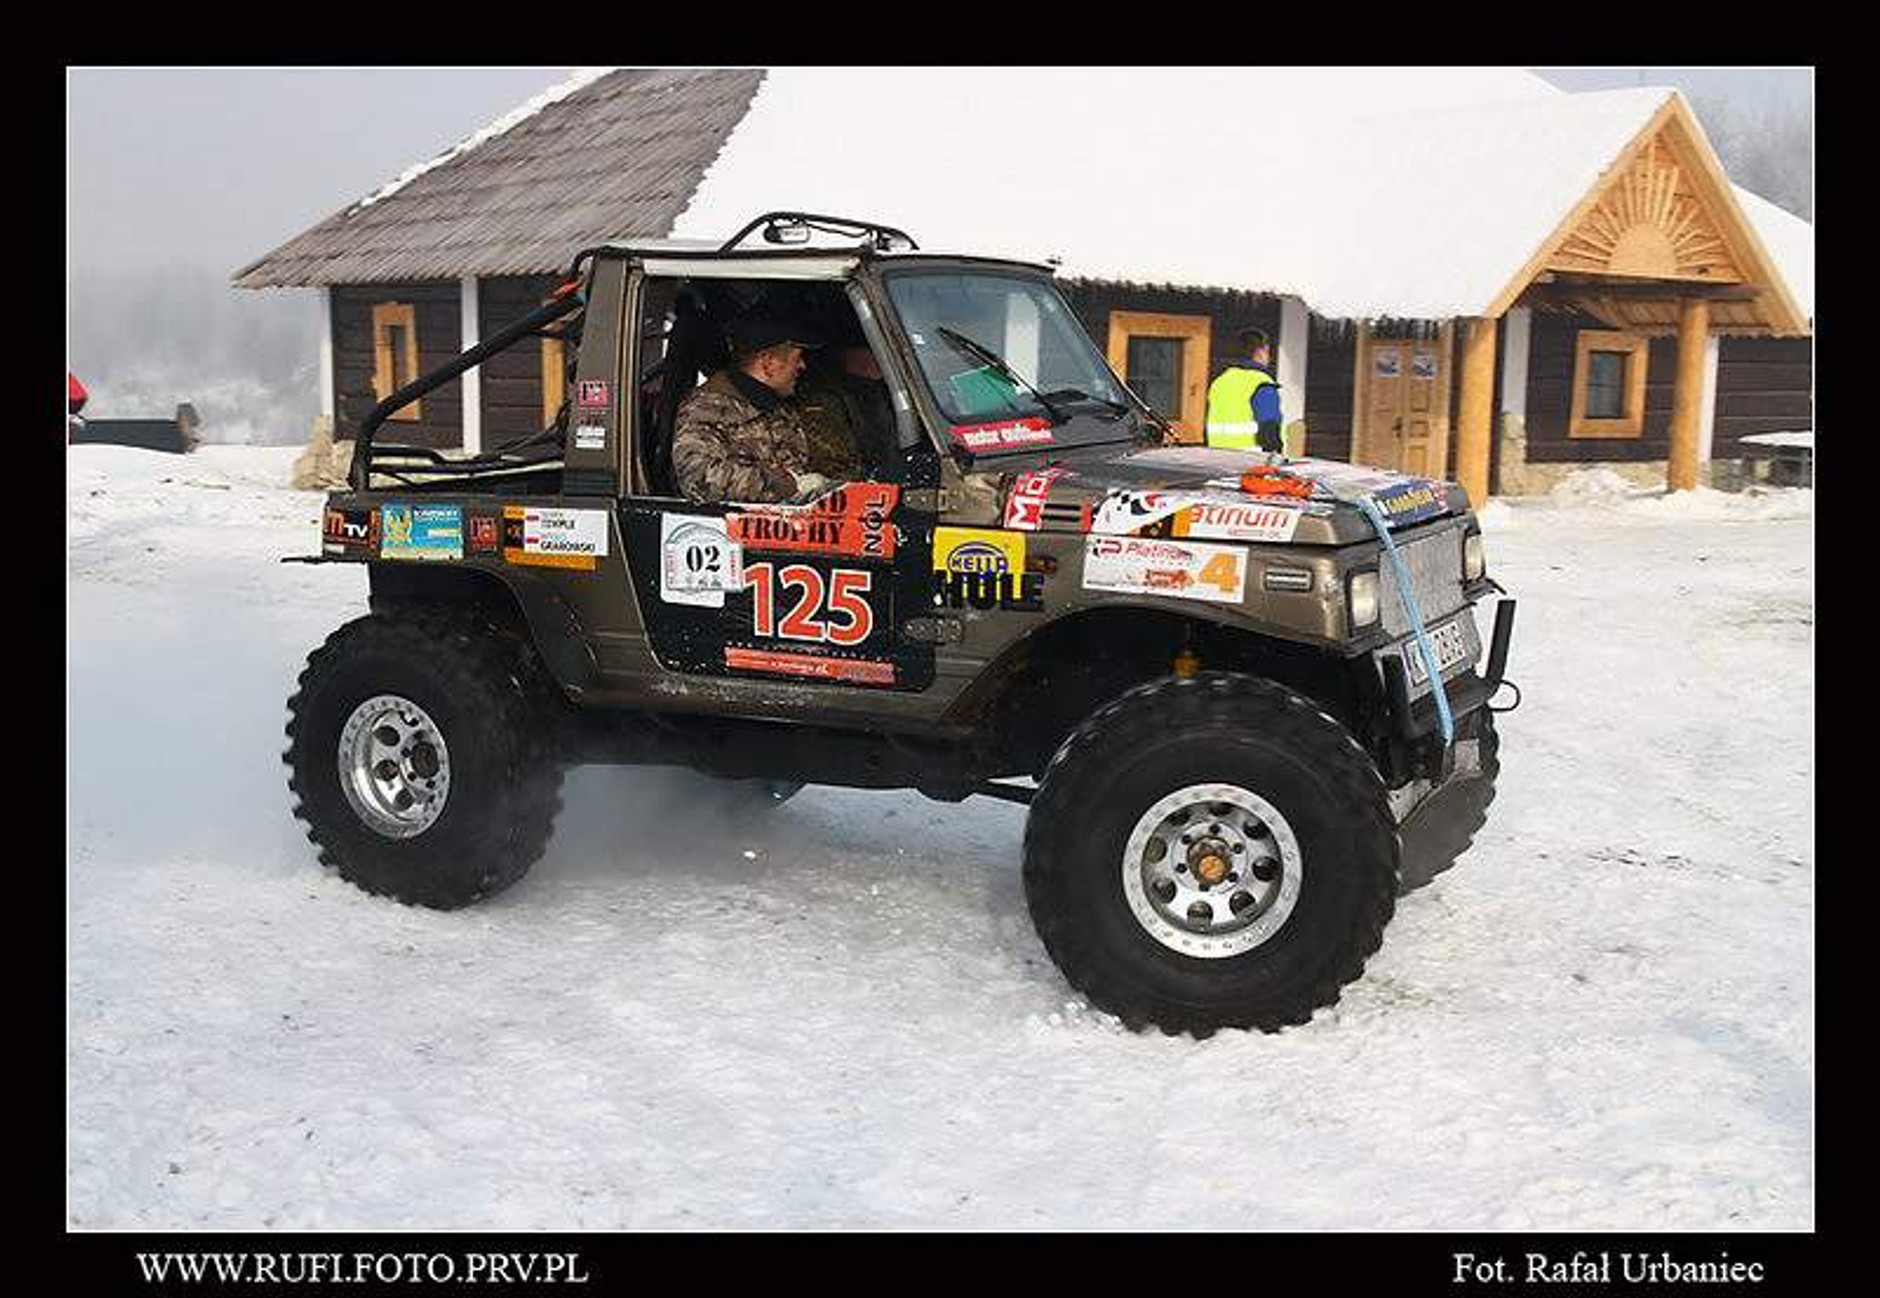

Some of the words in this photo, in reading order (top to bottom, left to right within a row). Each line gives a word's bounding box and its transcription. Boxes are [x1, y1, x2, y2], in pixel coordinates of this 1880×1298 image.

[737, 515, 845, 545] TROPHY
[686, 545, 720, 573] 02
[1199, 551, 1241, 594] 4
[741, 563, 873, 646] 125
